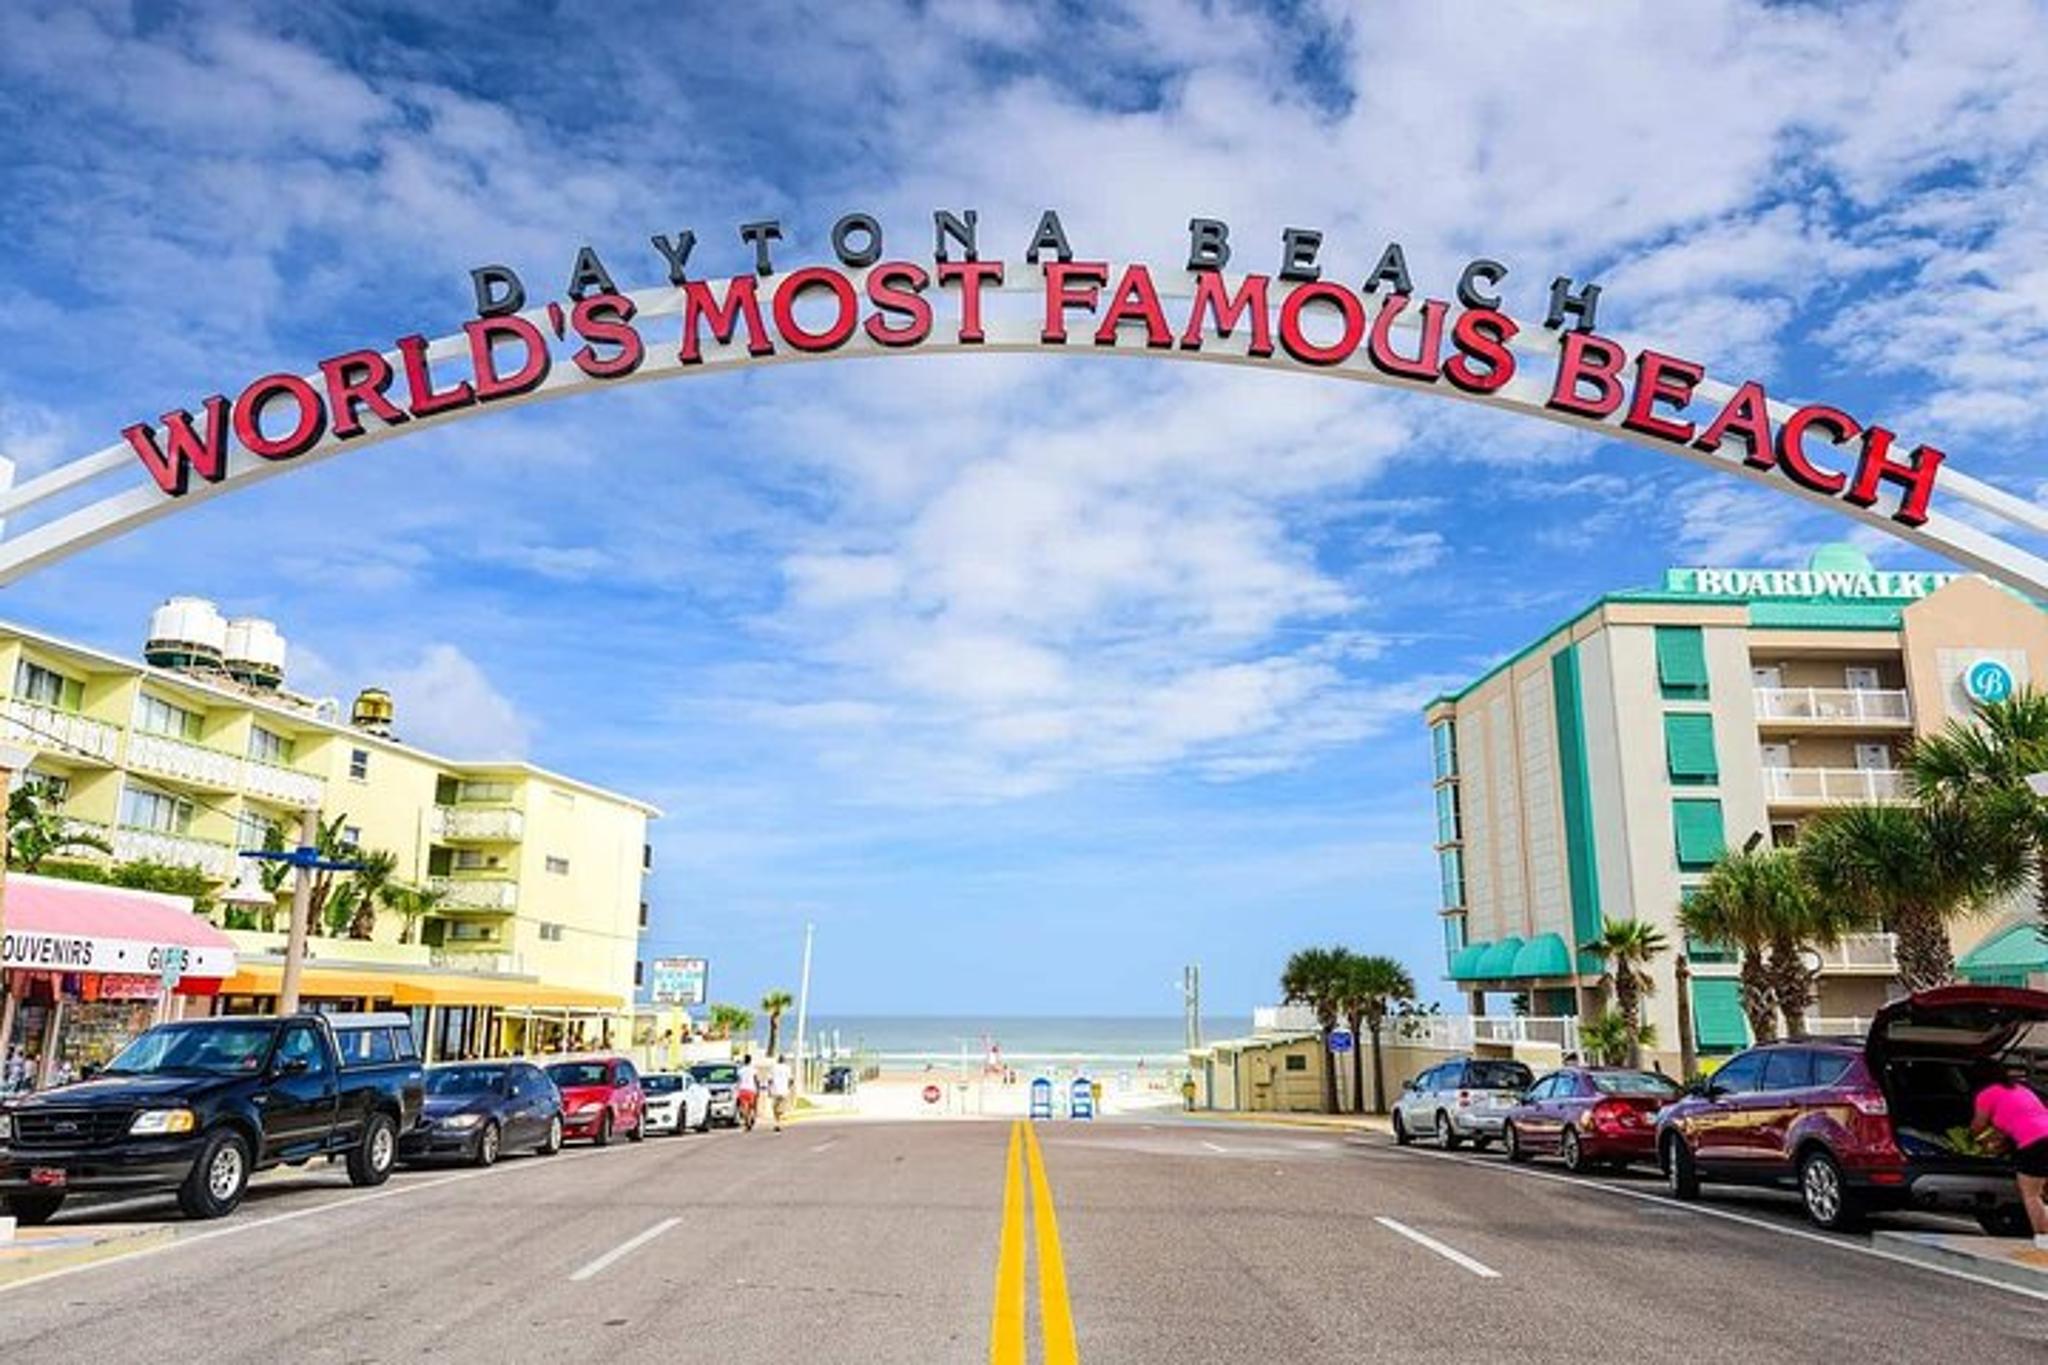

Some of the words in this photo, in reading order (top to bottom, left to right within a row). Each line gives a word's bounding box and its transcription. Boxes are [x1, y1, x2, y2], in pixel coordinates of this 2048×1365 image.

[469, 210, 1073, 318] DAYTONA
[1186, 217, 1603, 334] BEACH
[121, 293, 645, 496] WORLD'S
[678, 260, 1003, 364] MOST
[1041, 261, 1520, 393] FAMOUS
[1546, 330, 1946, 528] BEACH
[1697, 570, 1926, 599] BOARDWALK
[2, 934, 93, 966] OUVENIRS
[148, 946, 190, 971] GIS
